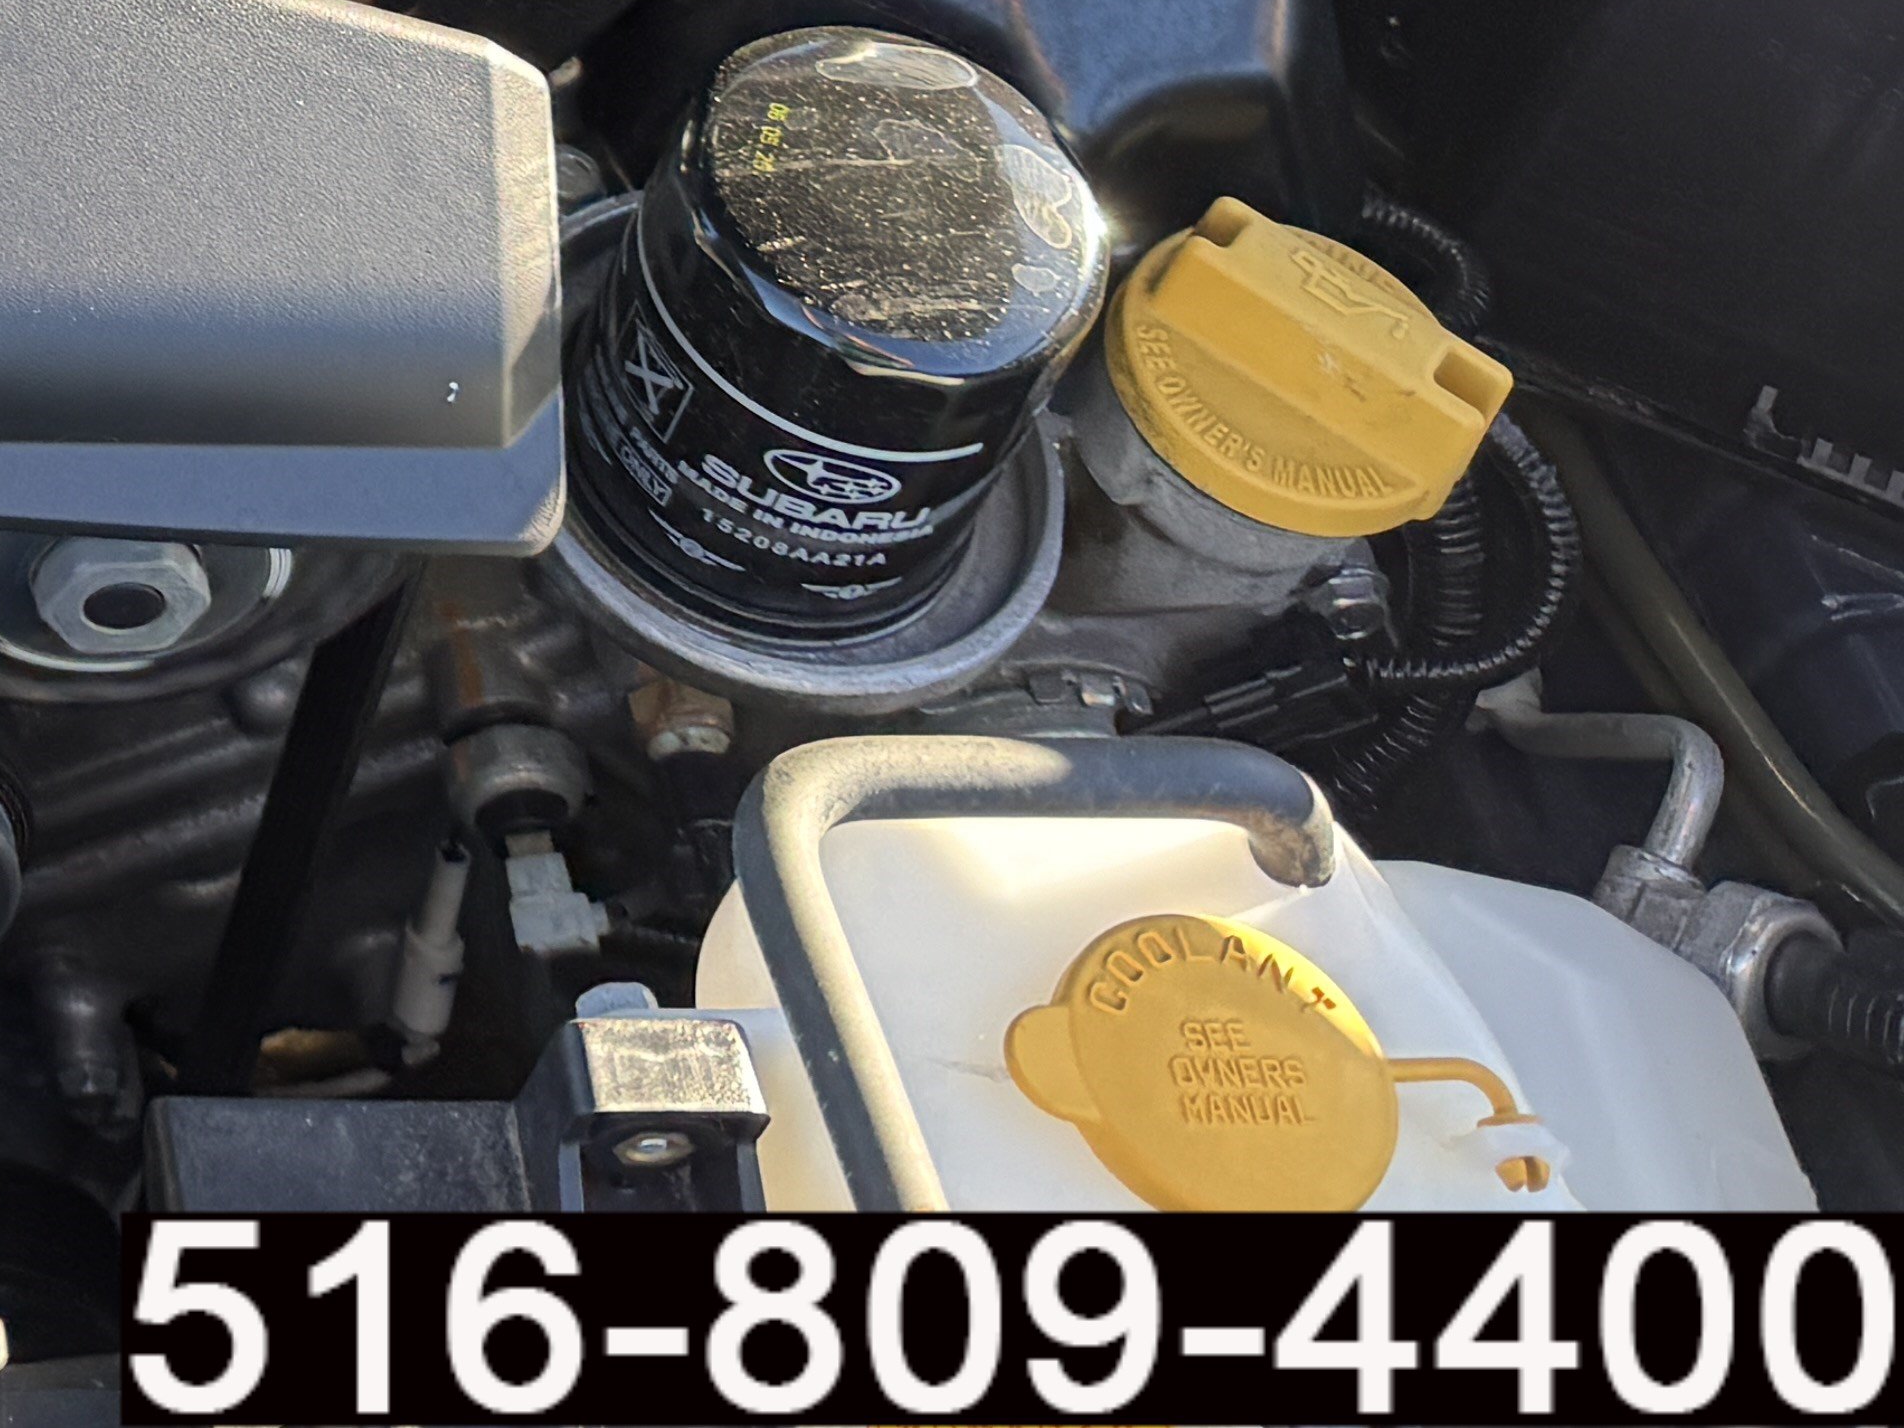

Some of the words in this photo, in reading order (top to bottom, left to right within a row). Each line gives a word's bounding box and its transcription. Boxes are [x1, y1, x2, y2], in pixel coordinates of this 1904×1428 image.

[1134, 322, 1179, 374] SEE
[1157, 372, 1266, 474] OWNER'S
[1270, 455, 1391, 500] MANUAL
[677, 459, 748, 515] MADE
[752, 508, 785, 530] IN
[790, 522, 935, 546] INDONESIA
[700, 453, 934, 532] SUBARU
[700, 507, 889, 568] 15208AA21A
[1179, 1018, 1251, 1051] SEE
[1168, 1054, 1308, 1090] OWNERS
[1178, 1092, 1318, 1127] MANUAL
